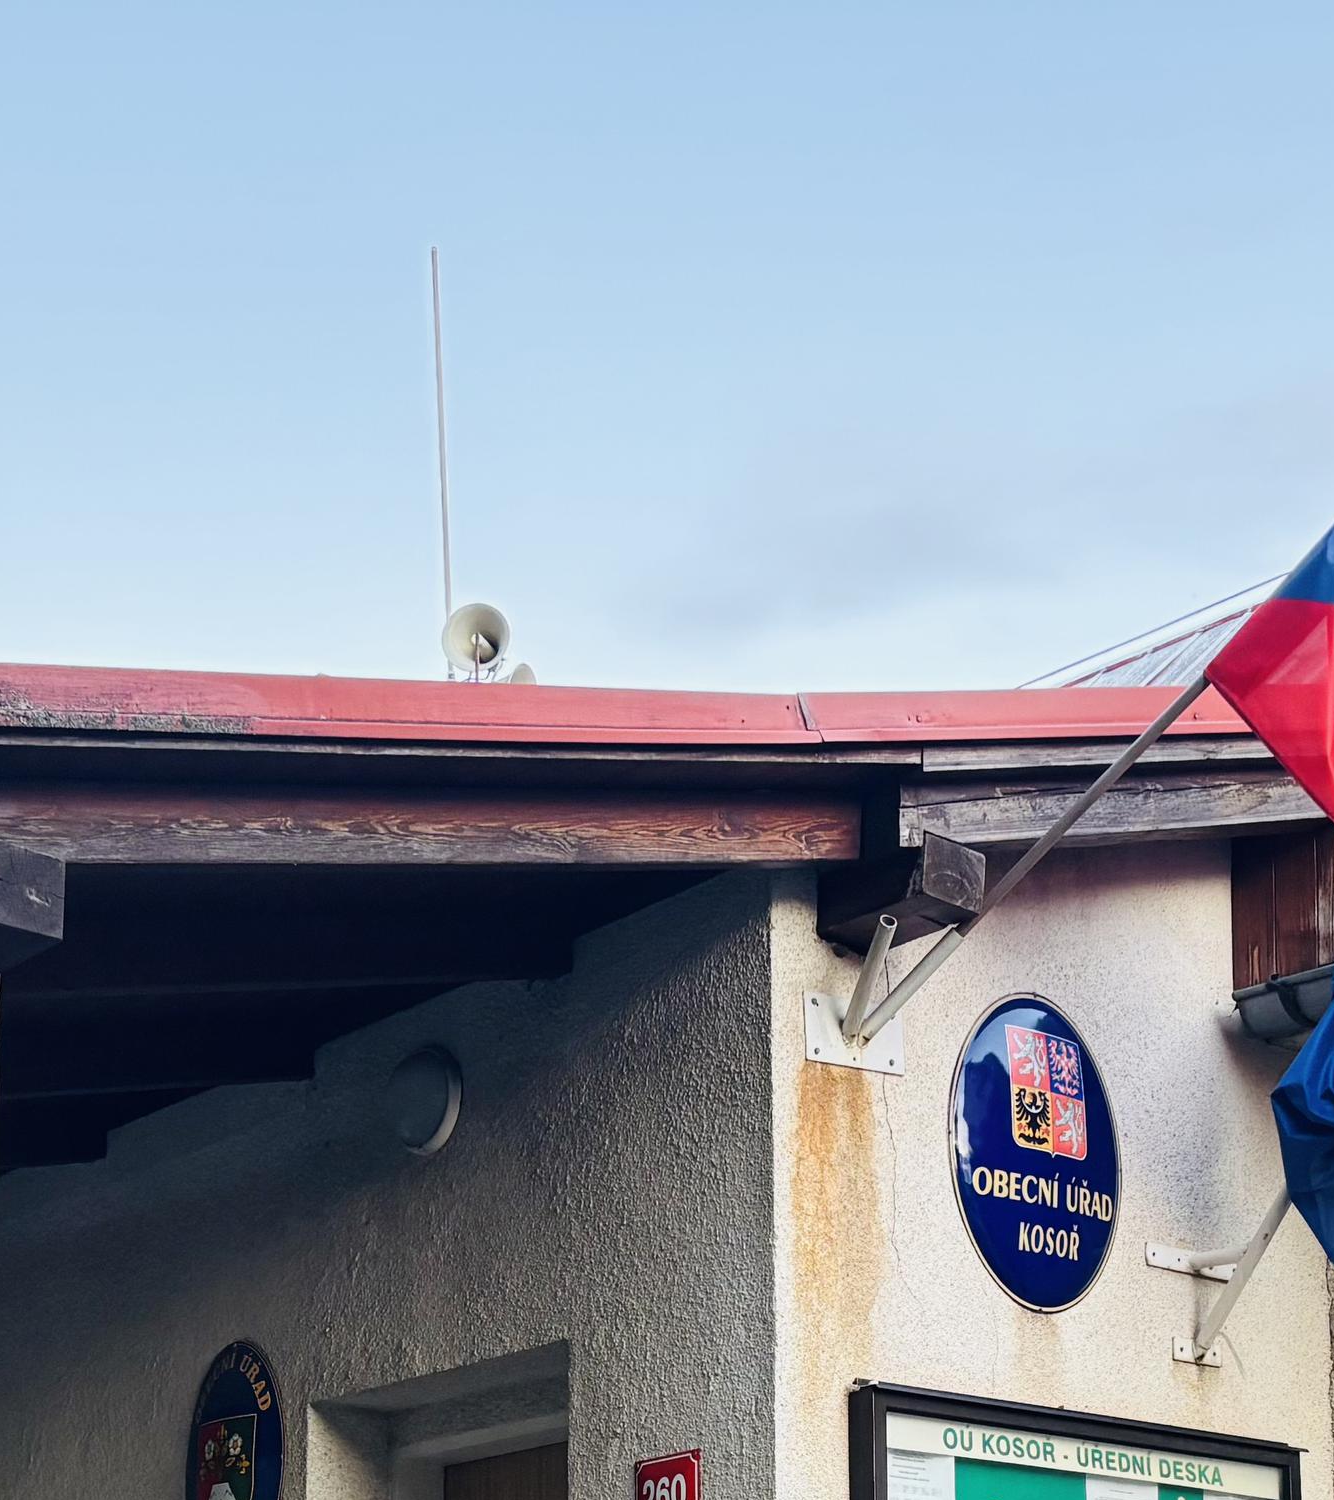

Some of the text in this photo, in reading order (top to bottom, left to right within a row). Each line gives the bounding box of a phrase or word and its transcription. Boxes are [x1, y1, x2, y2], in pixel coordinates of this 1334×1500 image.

[972, 1172, 1113, 1222] OBECNÍ ÚŘAD
[1018, 1221, 1080, 1261] KOSOŘ
[942, 1425, 973, 1452] OÚ
[982, 1432, 1056, 1463] KOSOŘ
[1076, 1441, 1153, 1477] ÚŘEDNÍ
[1159, 1458, 1224, 1487] DESKA
